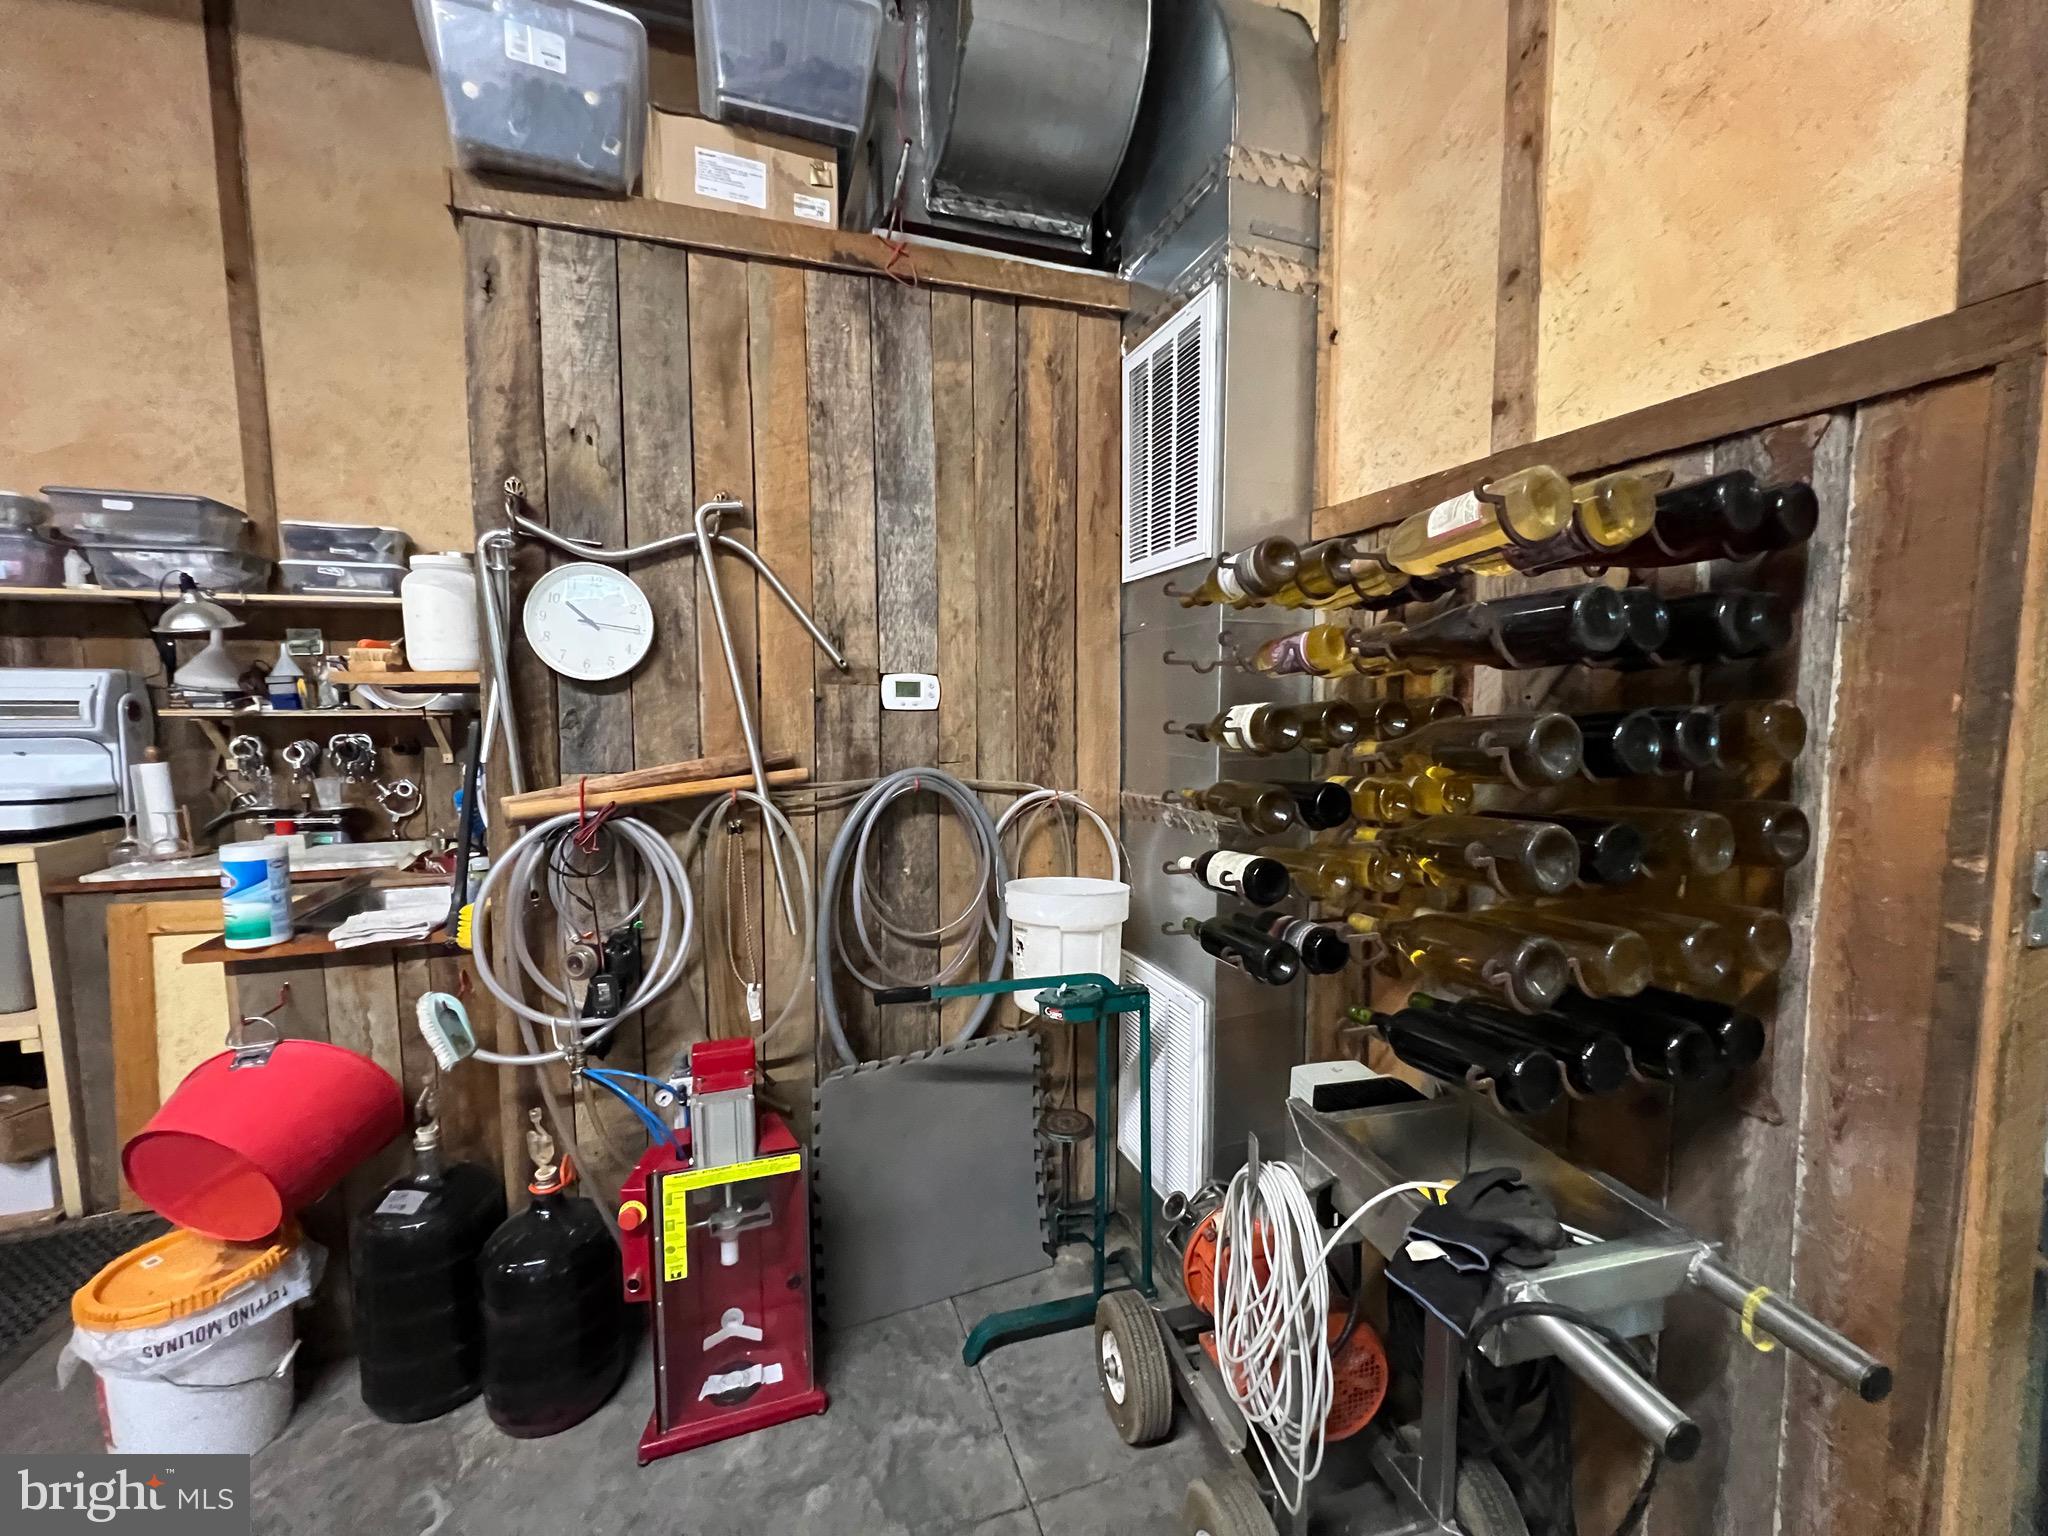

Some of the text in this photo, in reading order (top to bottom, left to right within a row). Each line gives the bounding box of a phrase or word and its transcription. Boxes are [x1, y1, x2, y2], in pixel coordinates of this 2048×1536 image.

[548, 591, 561, 604] 10
[629, 604, 638, 615] 2
[539, 610, 547, 621] 9
[542, 630, 551, 641] 8
[559, 648, 568, 660] 7
[583, 658, 591, 669] 6
[607, 656, 616, 667] 5
[142, 1318, 223, 1359] MOLINAS
